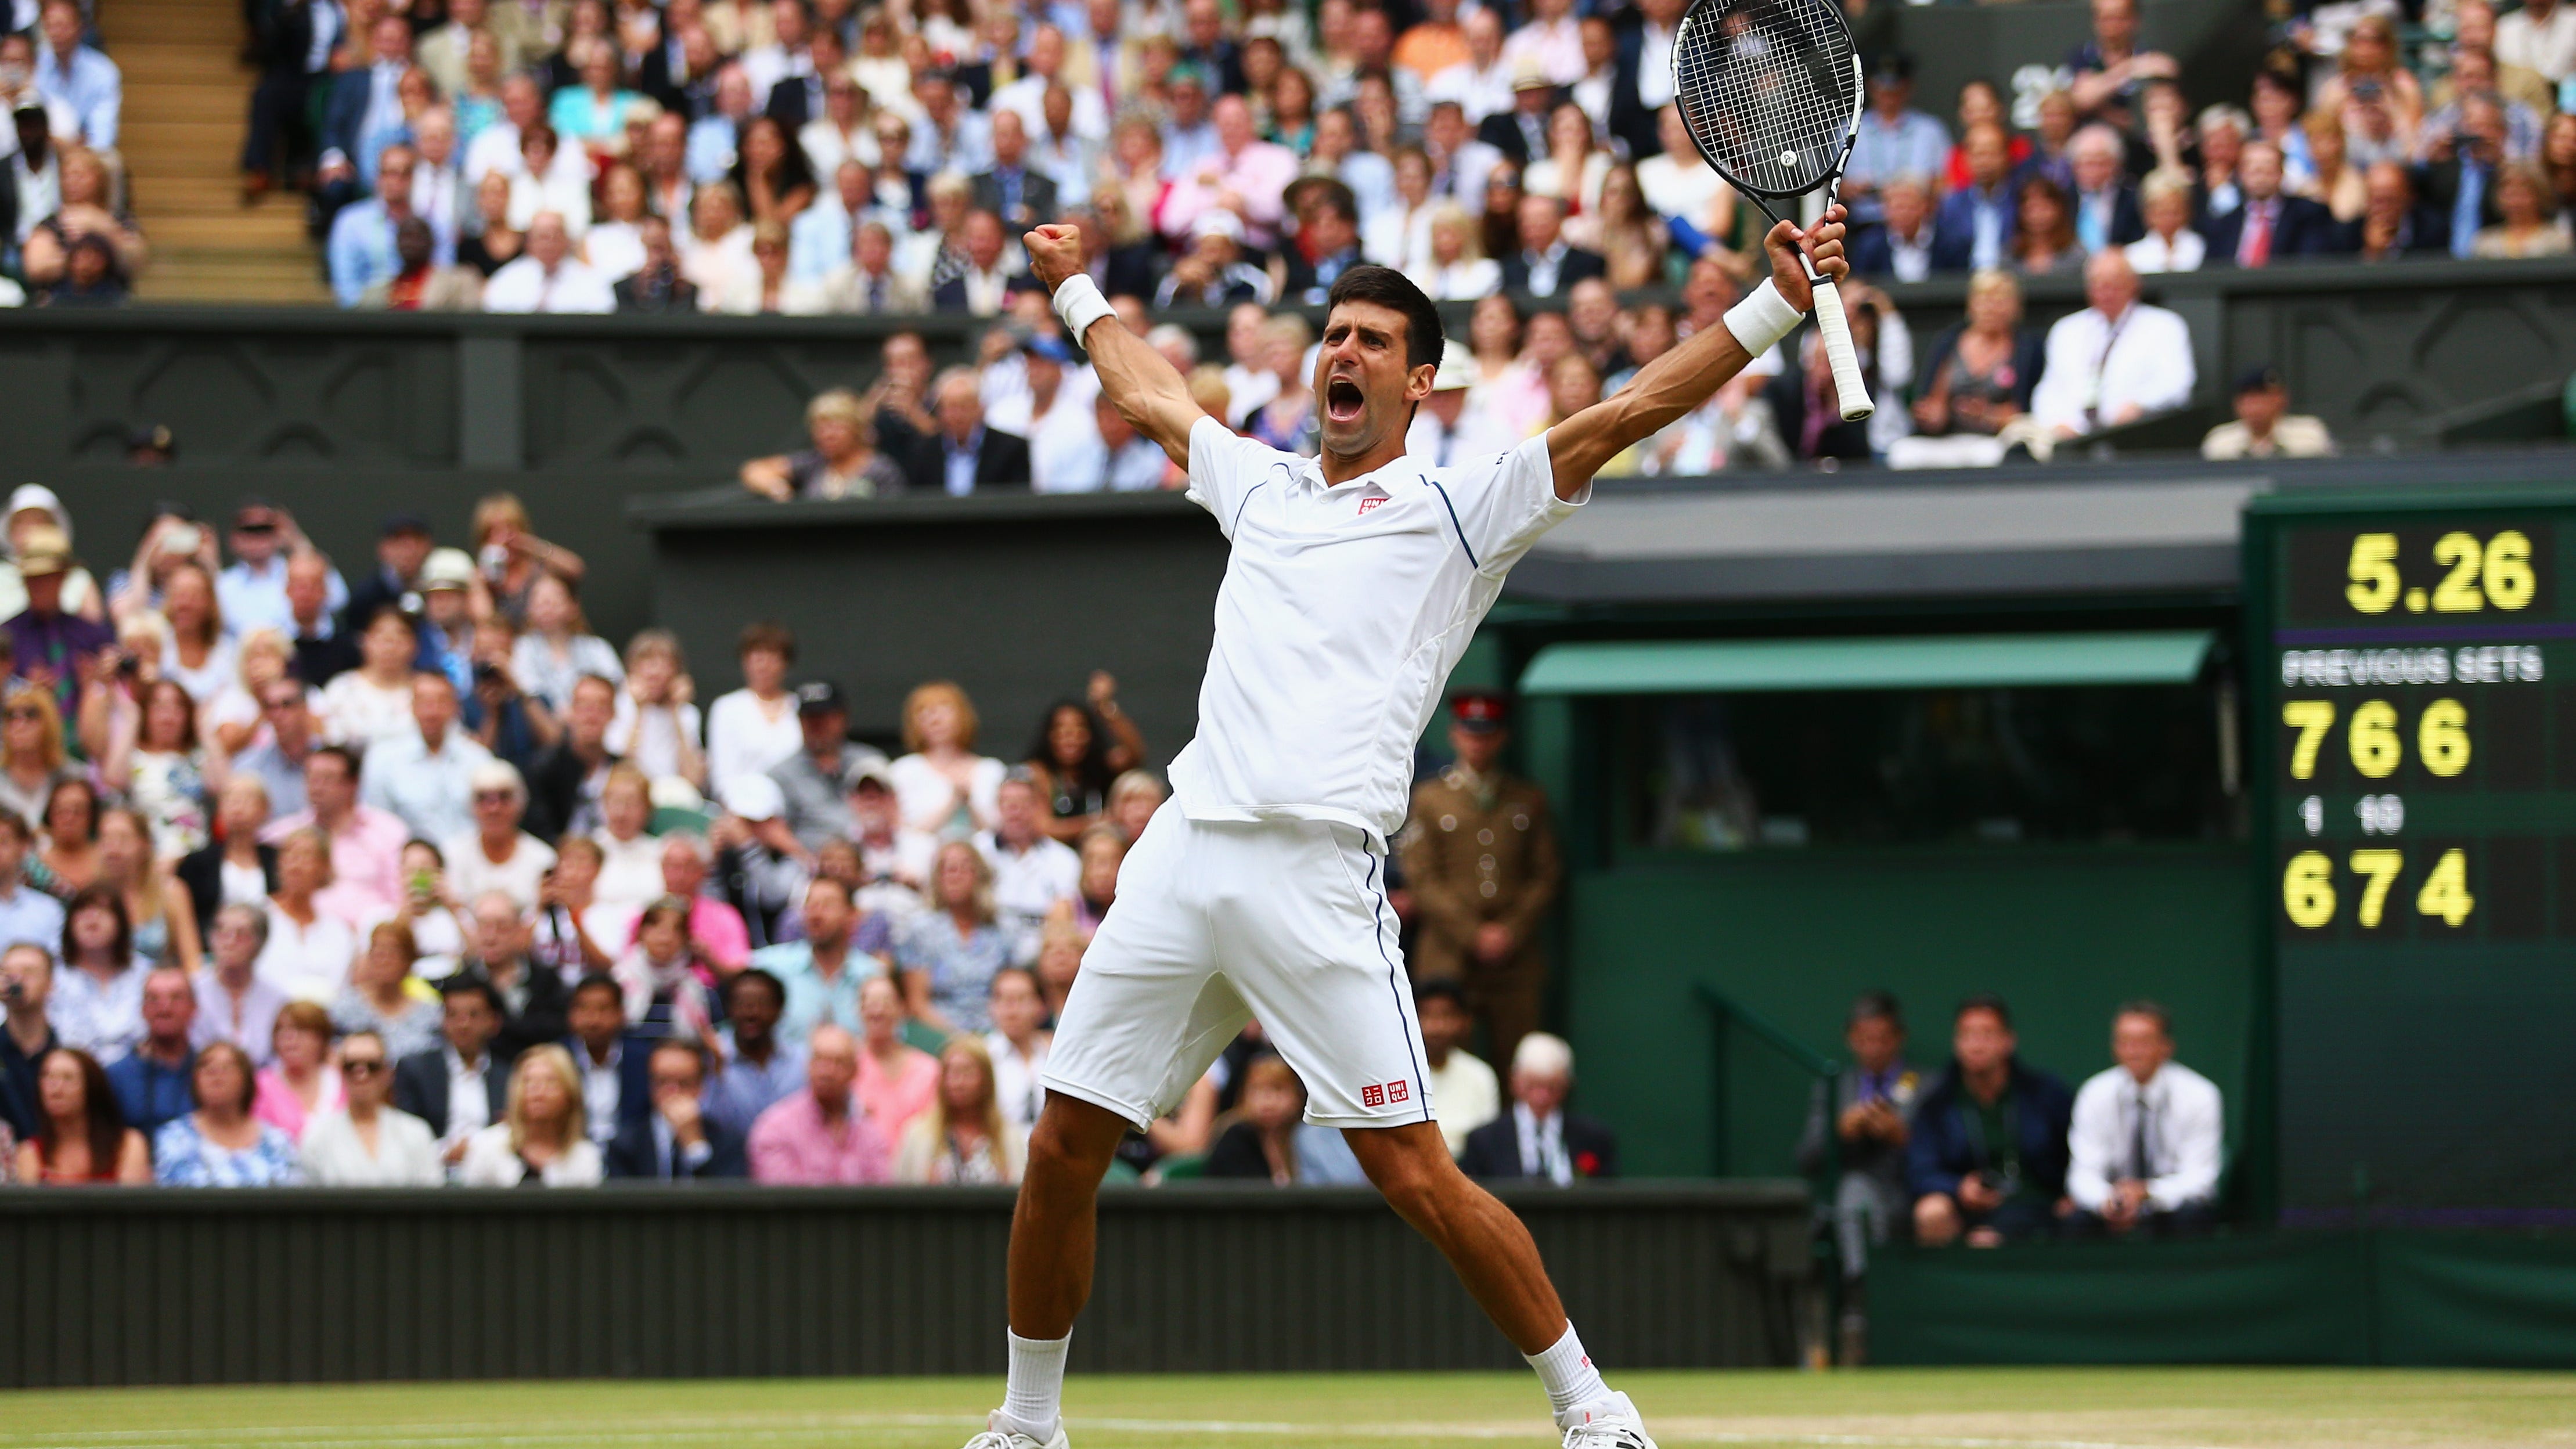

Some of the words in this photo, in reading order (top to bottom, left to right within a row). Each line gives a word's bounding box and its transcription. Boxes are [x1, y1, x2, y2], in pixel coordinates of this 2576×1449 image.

[2346, 531, 2536, 613] 5.26
[2282, 647, 2451, 687] PREVIOUS
[2455, 645, 2544, 683] SETS
[2282, 700, 2336, 780] 7
[2348, 700, 2401, 778] 6
[2418, 698, 2471, 777] 6
[2299, 795, 2323, 837] 1
[2283, 850, 2336, 928] 6
[2349, 849, 2403, 927] 7
[2417, 848, 2474, 927] 4
[1389, 1082, 1404, 1092] UNI
[1391, 1091, 1407, 1101] QLO
